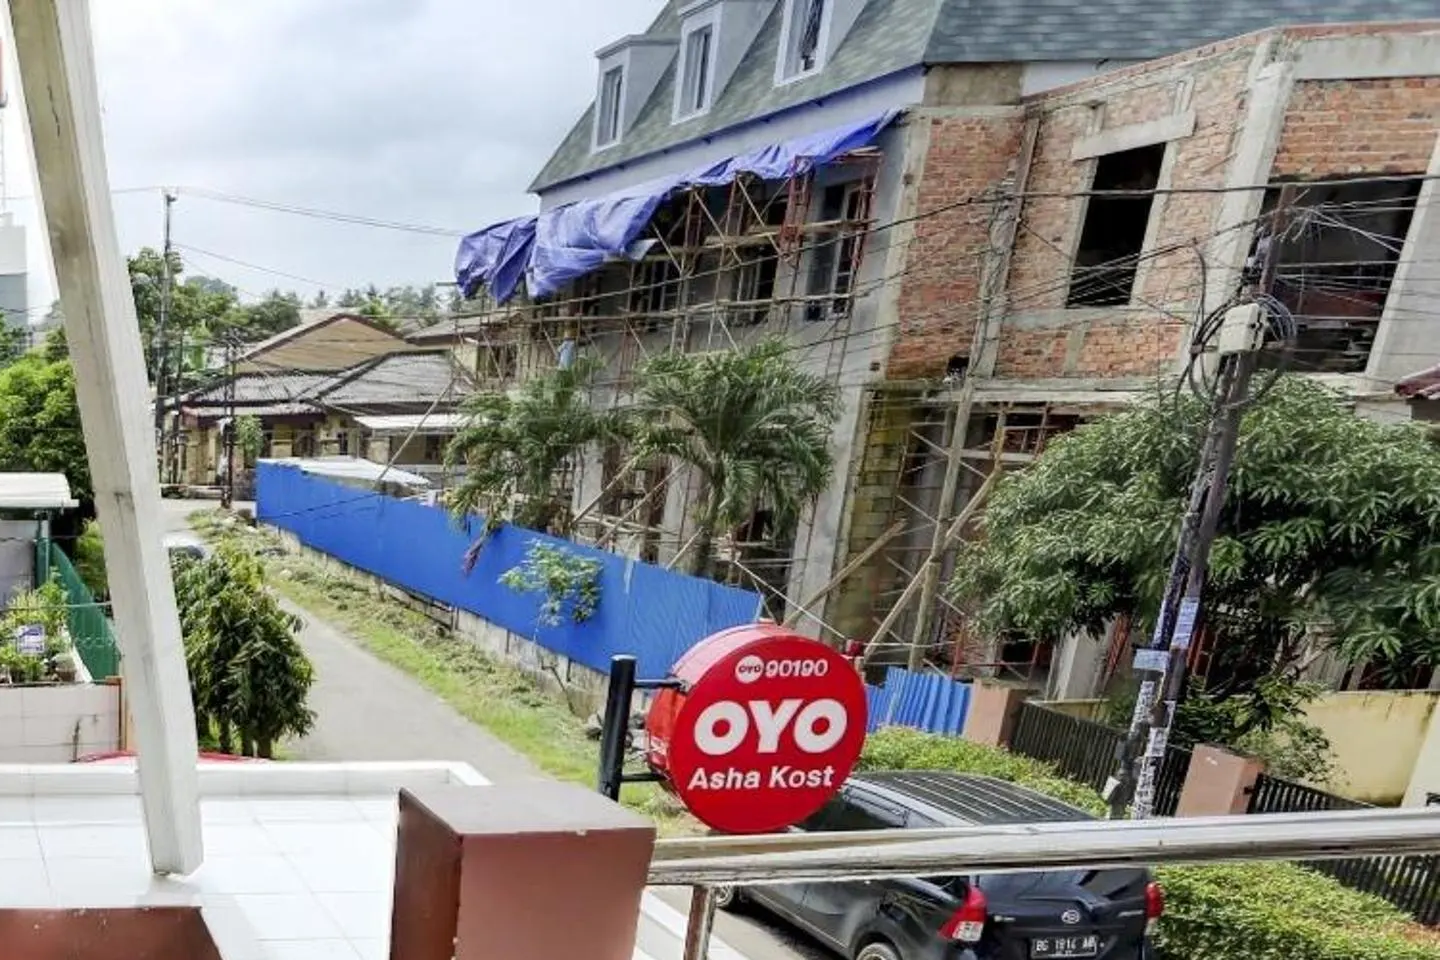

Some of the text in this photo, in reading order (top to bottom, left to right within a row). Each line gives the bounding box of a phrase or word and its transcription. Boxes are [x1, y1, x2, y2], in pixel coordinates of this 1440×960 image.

[765, 659, 828, 677] 90190
[694, 698, 848, 756] OYO
[687, 765, 835, 790] Asha Kost
